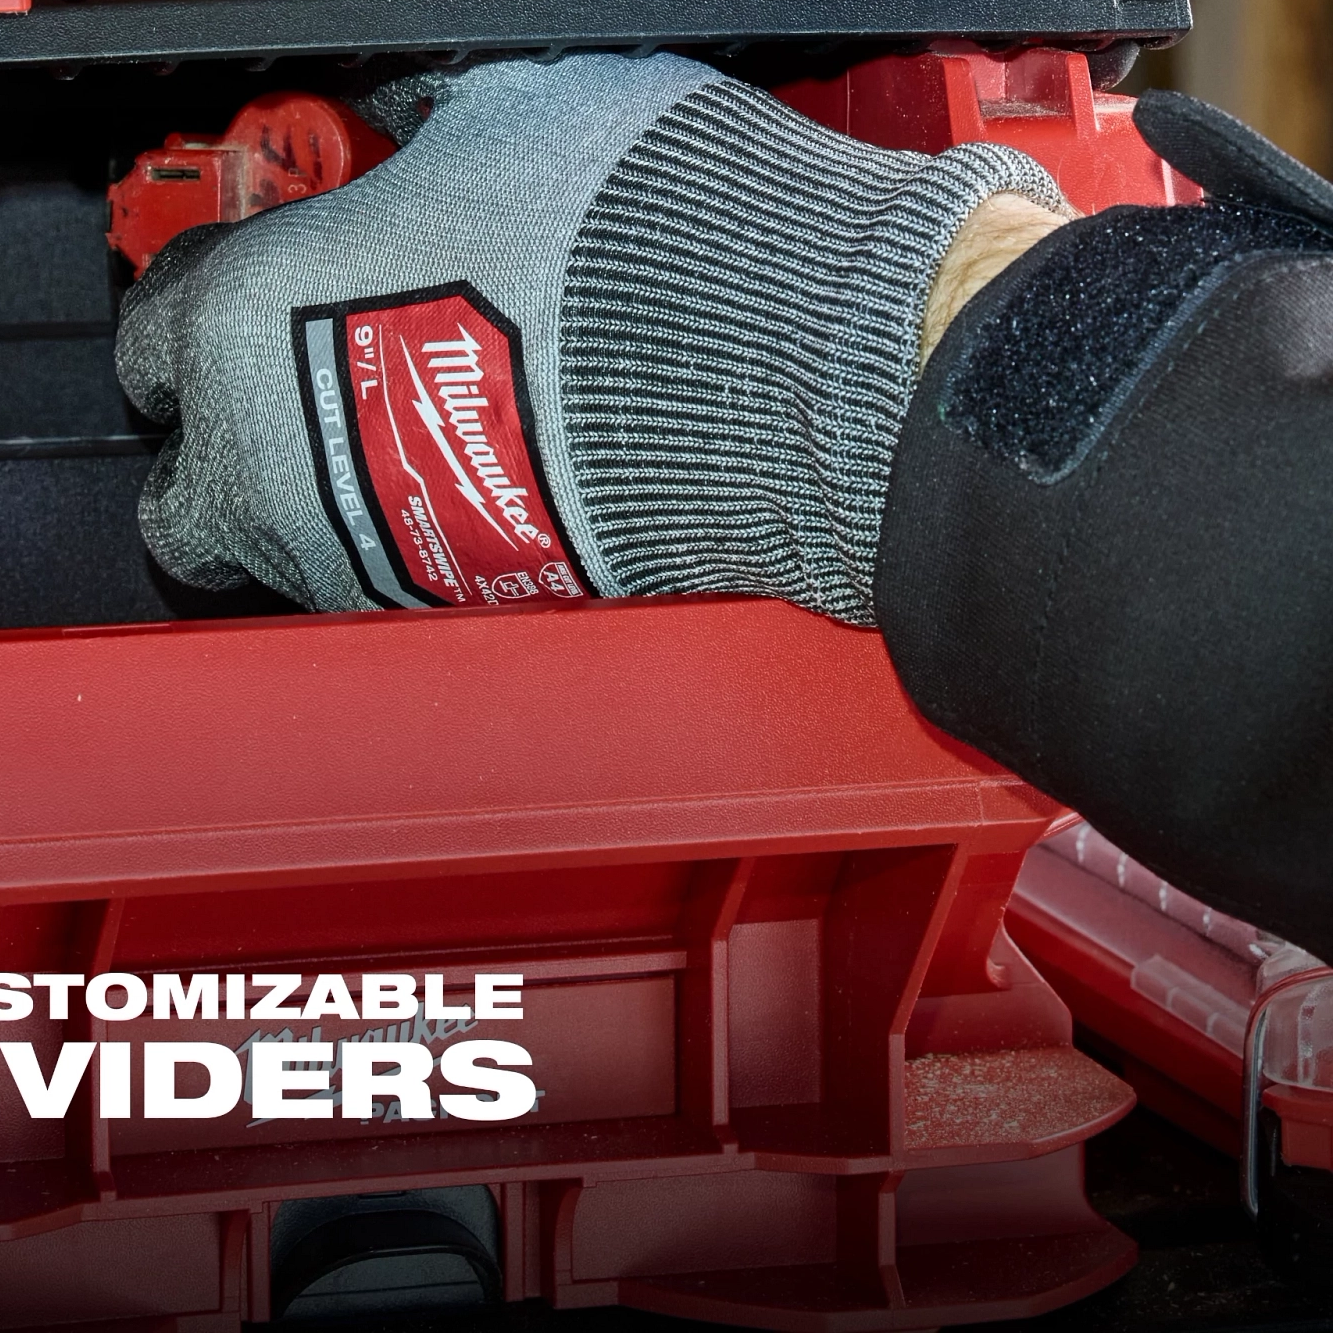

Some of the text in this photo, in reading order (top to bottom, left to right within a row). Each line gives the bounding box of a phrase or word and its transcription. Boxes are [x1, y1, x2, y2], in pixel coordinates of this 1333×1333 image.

[315, 368, 378, 552] CUT LEVEL 4
[401, 509, 438, 582] 48-73-8742
[517, 572, 539, 595] EN388
[543, 571, 565, 592] A4
